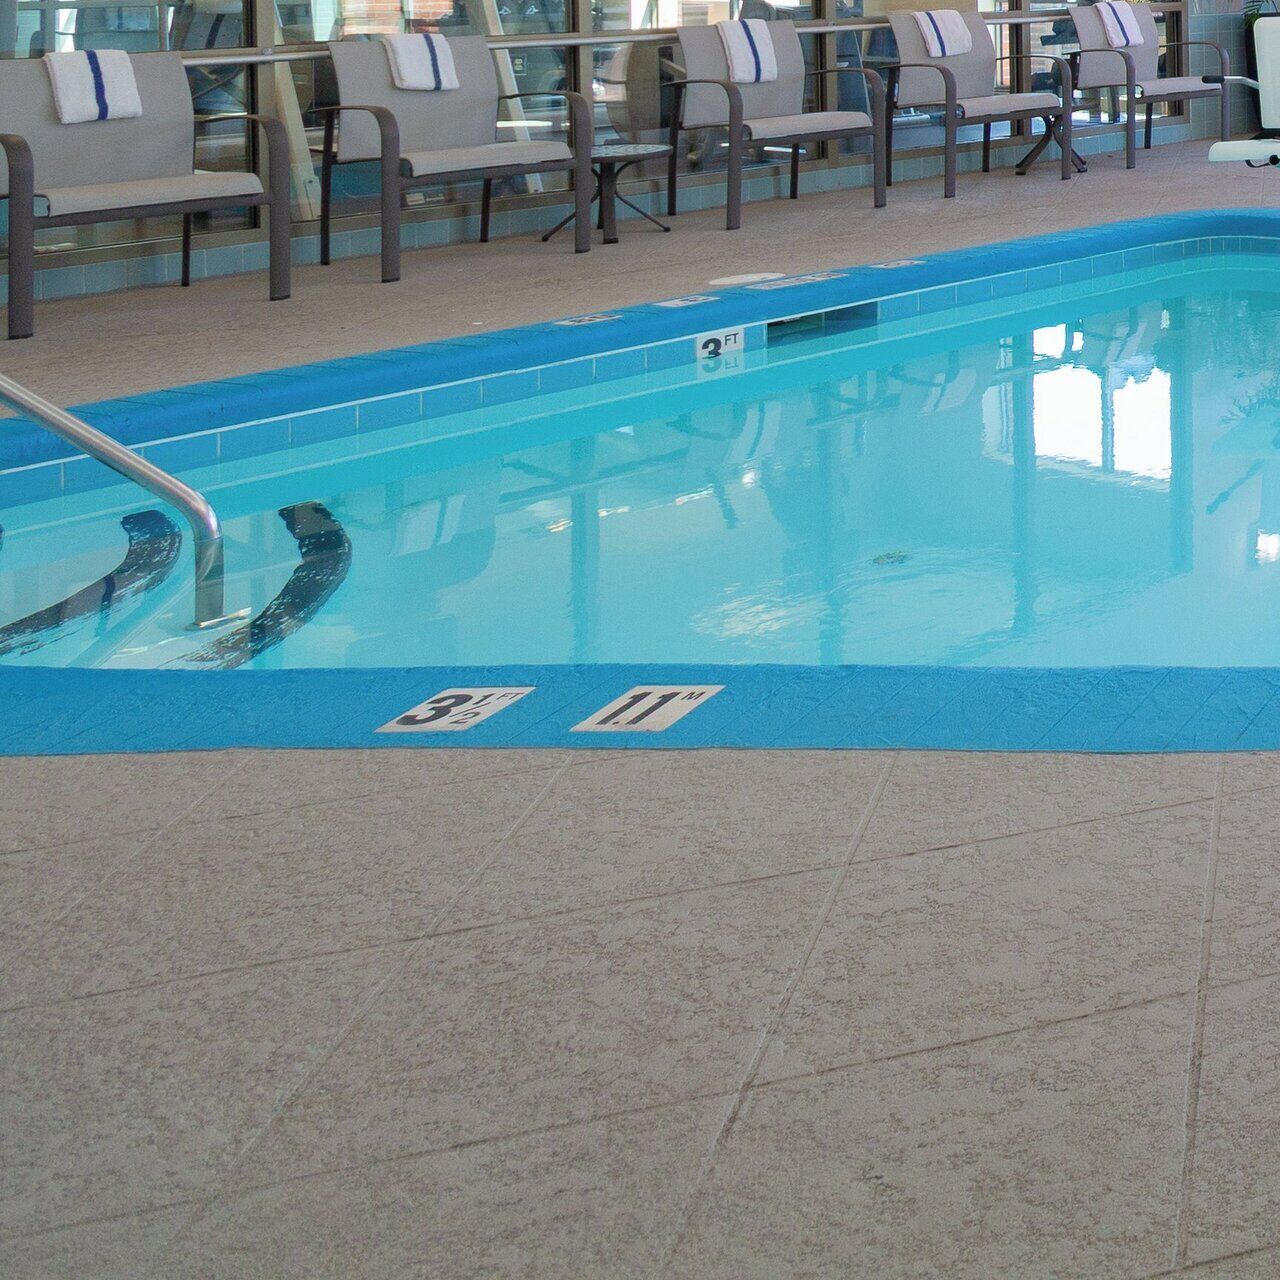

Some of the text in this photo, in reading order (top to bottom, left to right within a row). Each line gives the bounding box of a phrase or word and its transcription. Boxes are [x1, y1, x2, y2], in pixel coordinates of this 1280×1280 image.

[724, 332, 739, 346] FT
[680, 691, 706, 701] M
[396, 693, 474, 726] 3
[496, 692, 525, 702] FT
